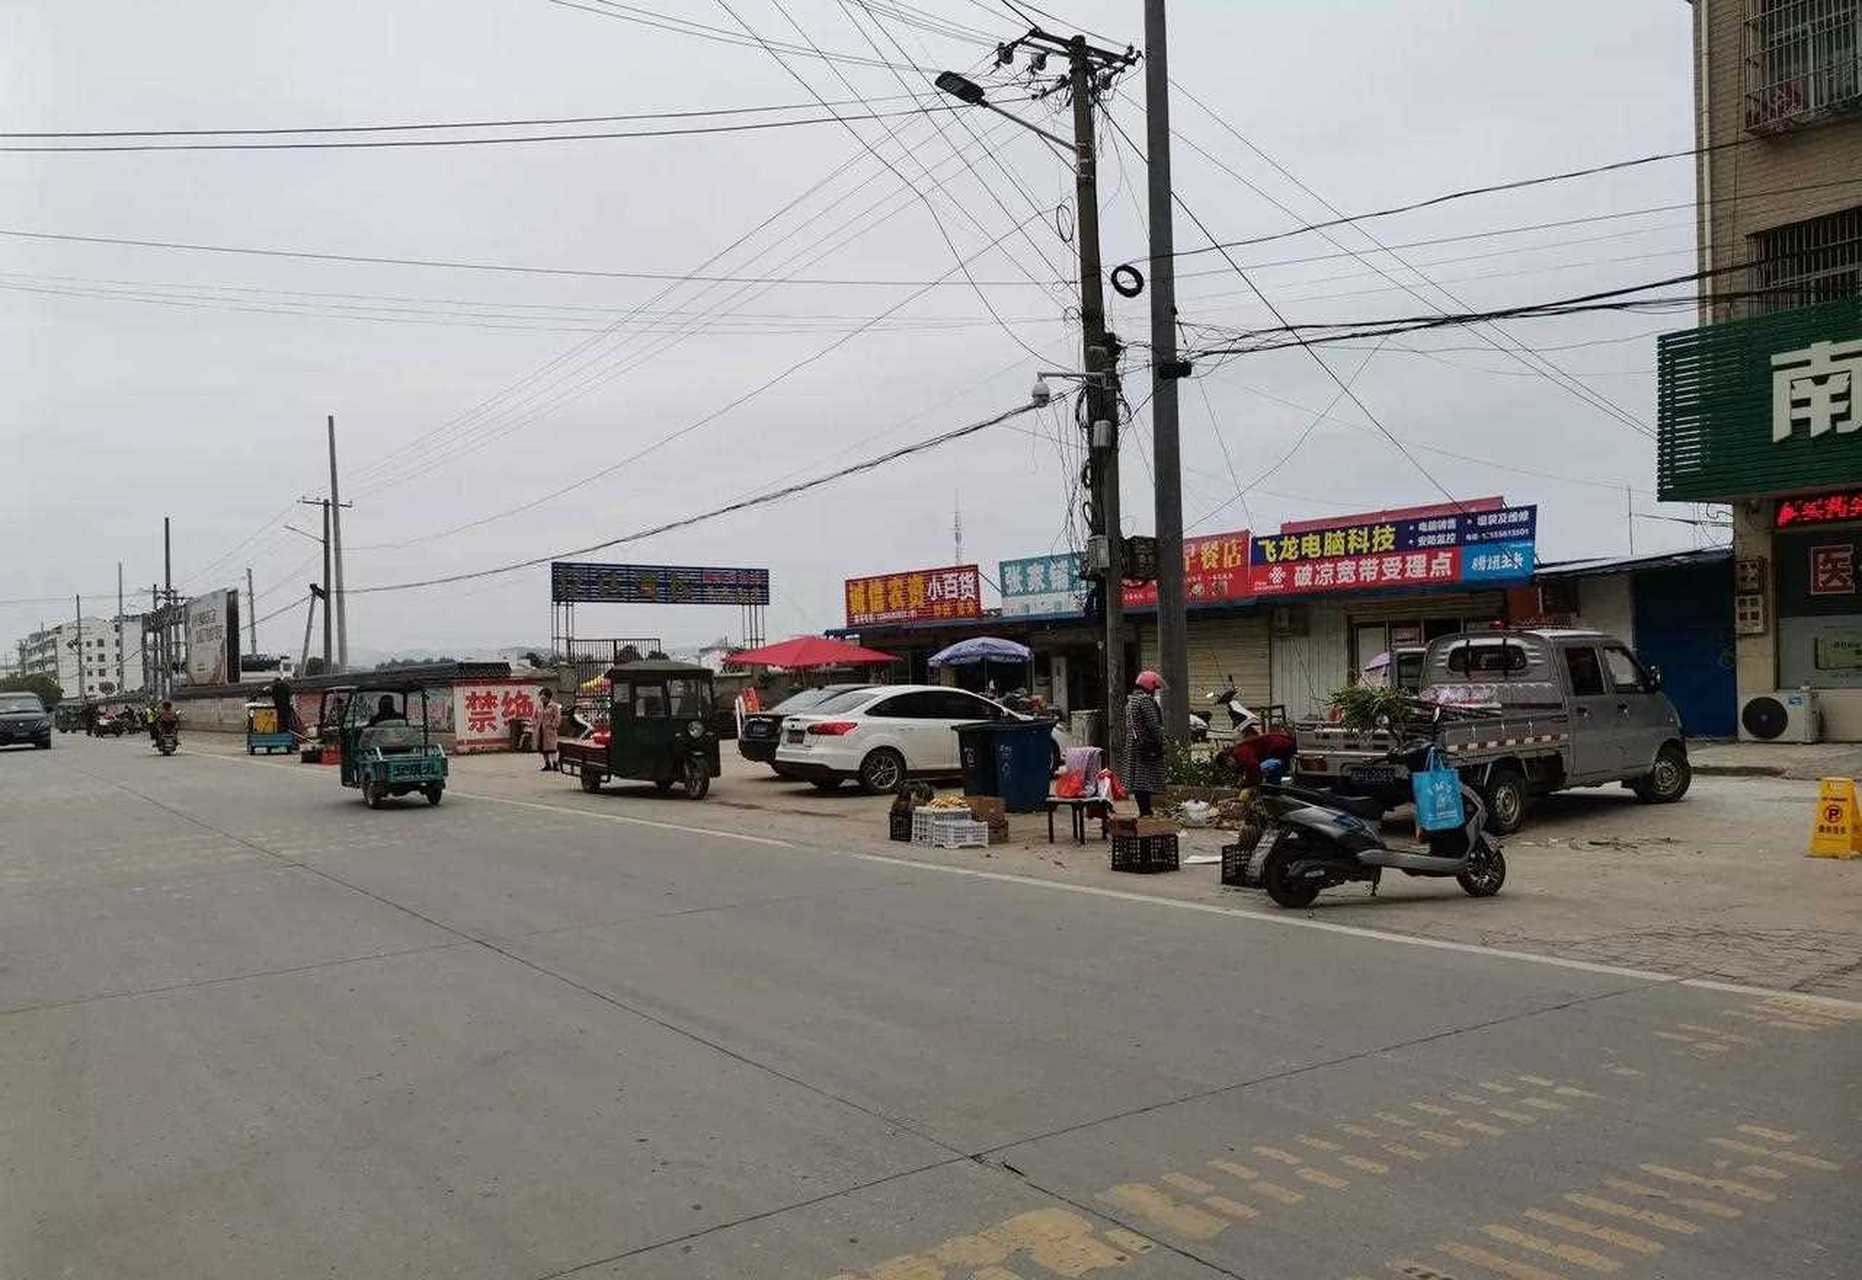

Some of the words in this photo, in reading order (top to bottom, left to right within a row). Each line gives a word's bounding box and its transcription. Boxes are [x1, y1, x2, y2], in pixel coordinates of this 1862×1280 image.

[1770, 339, 1862, 443] 南
[1258, 525, 1397, 563] 飞龙电脑科技
[1293, 551, 1453, 587] 破凉宽带受理点
